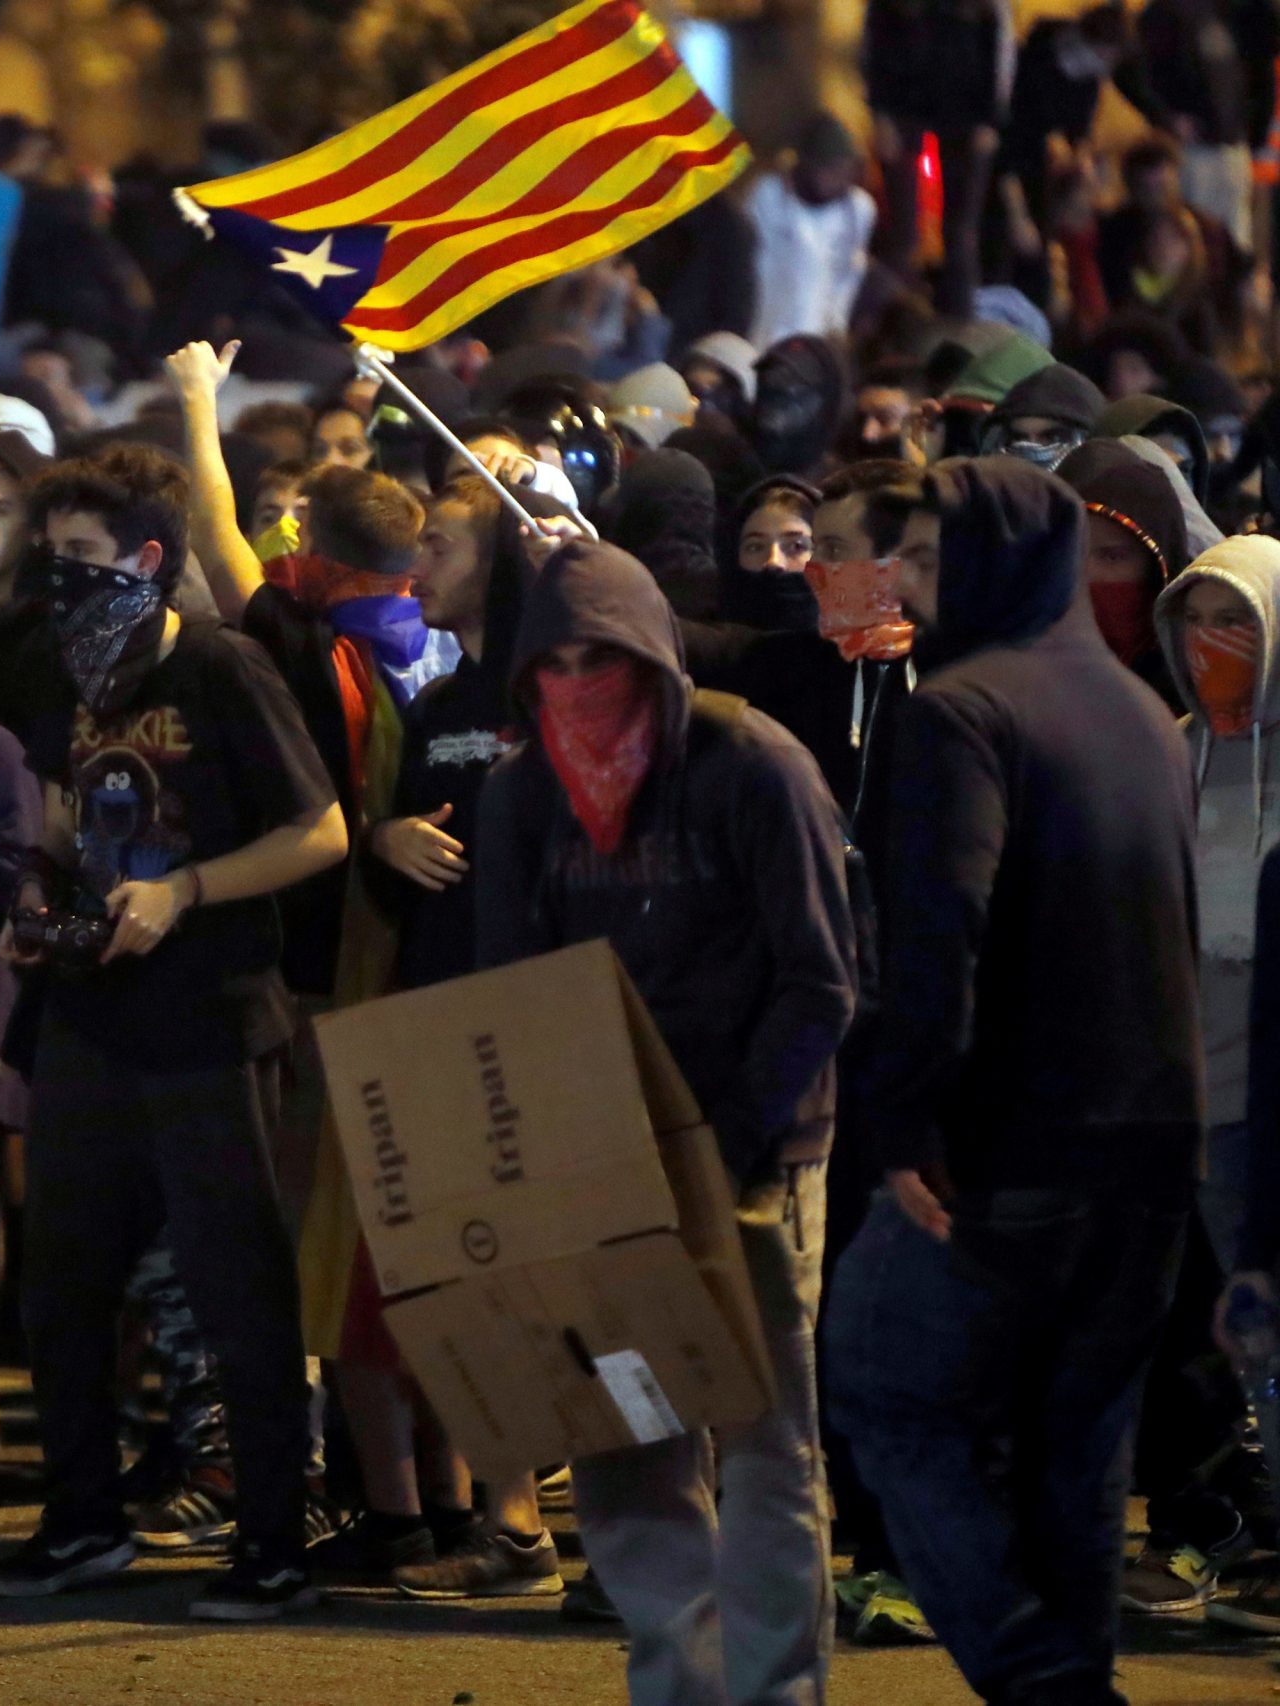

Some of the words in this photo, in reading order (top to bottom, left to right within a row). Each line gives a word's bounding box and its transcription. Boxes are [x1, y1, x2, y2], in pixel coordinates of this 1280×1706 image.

[72, 703, 194, 752] OKIE
[362, 1079, 414, 1227] fripan
[475, 1033, 525, 1184] fripan
